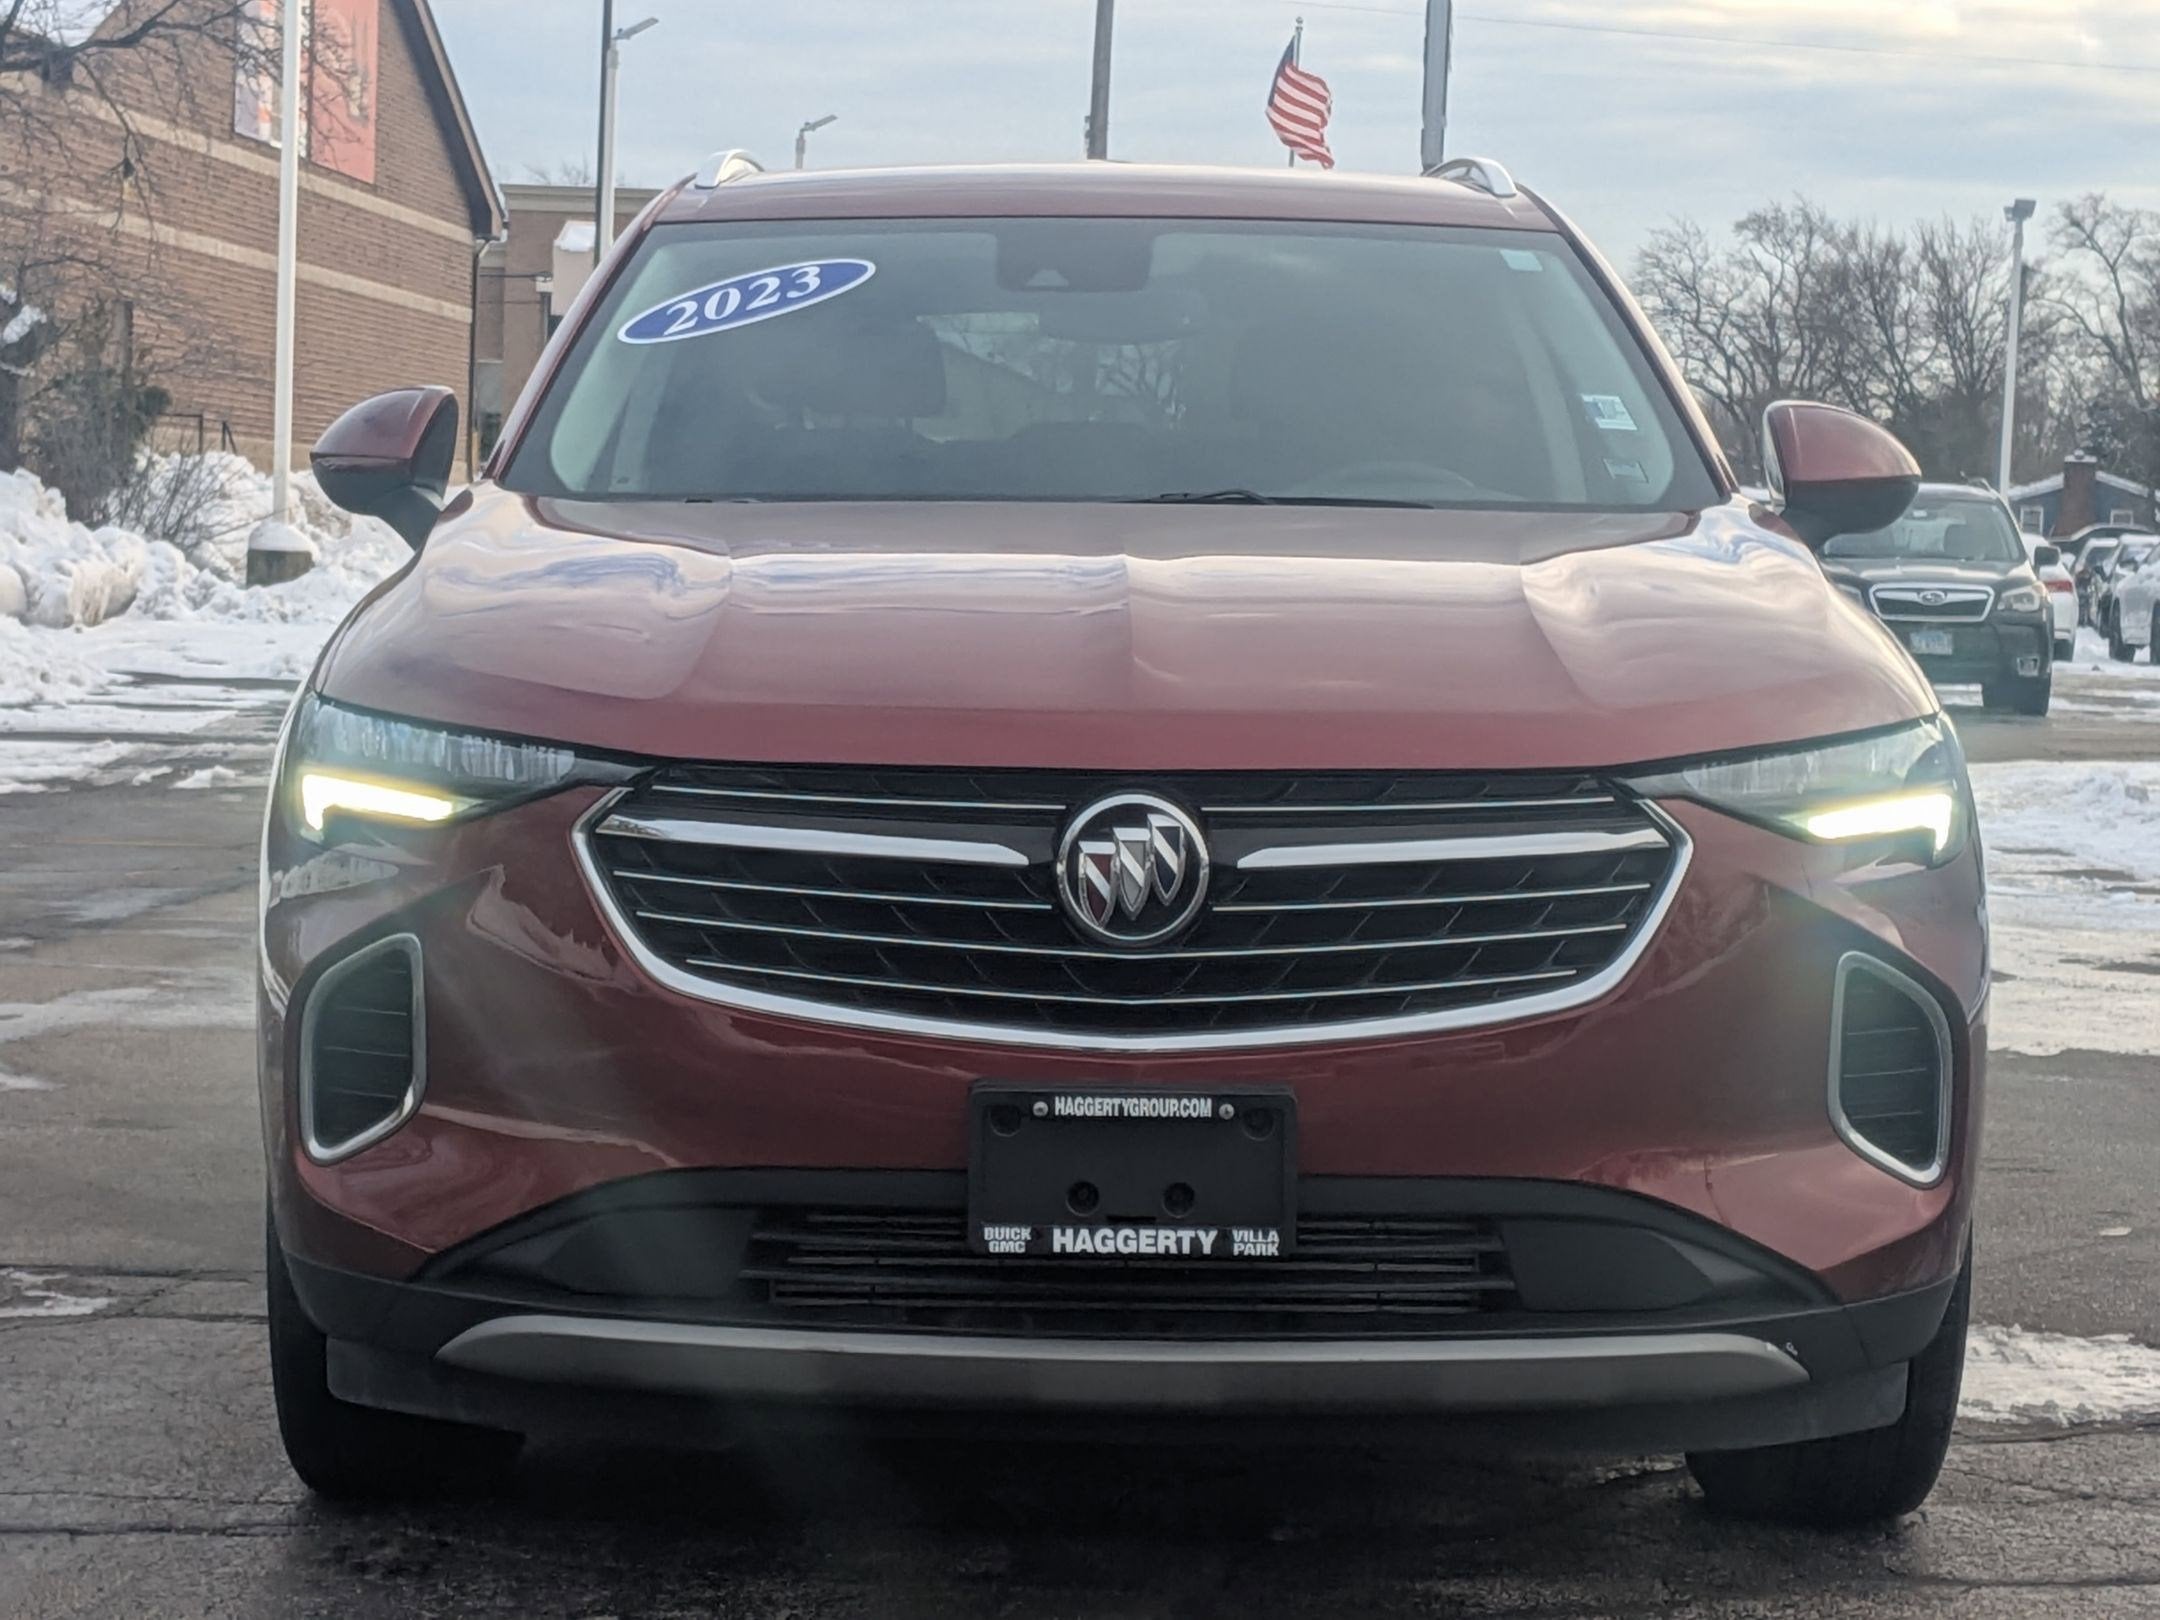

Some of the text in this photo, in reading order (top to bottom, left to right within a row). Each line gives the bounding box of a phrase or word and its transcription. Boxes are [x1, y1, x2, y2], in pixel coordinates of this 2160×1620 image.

[663, 265, 822, 336] 2023
[1054, 1096, 1213, 1118] HAGGERTYGROUP.COM
[983, 1226, 1032, 1241] BUICK
[1052, 1227, 1219, 1255] HAGGERTY
[1231, 1228, 1280, 1243] VILLA
[988, 1241, 1026, 1254] GMC
[1232, 1242, 1280, 1256] PARK
